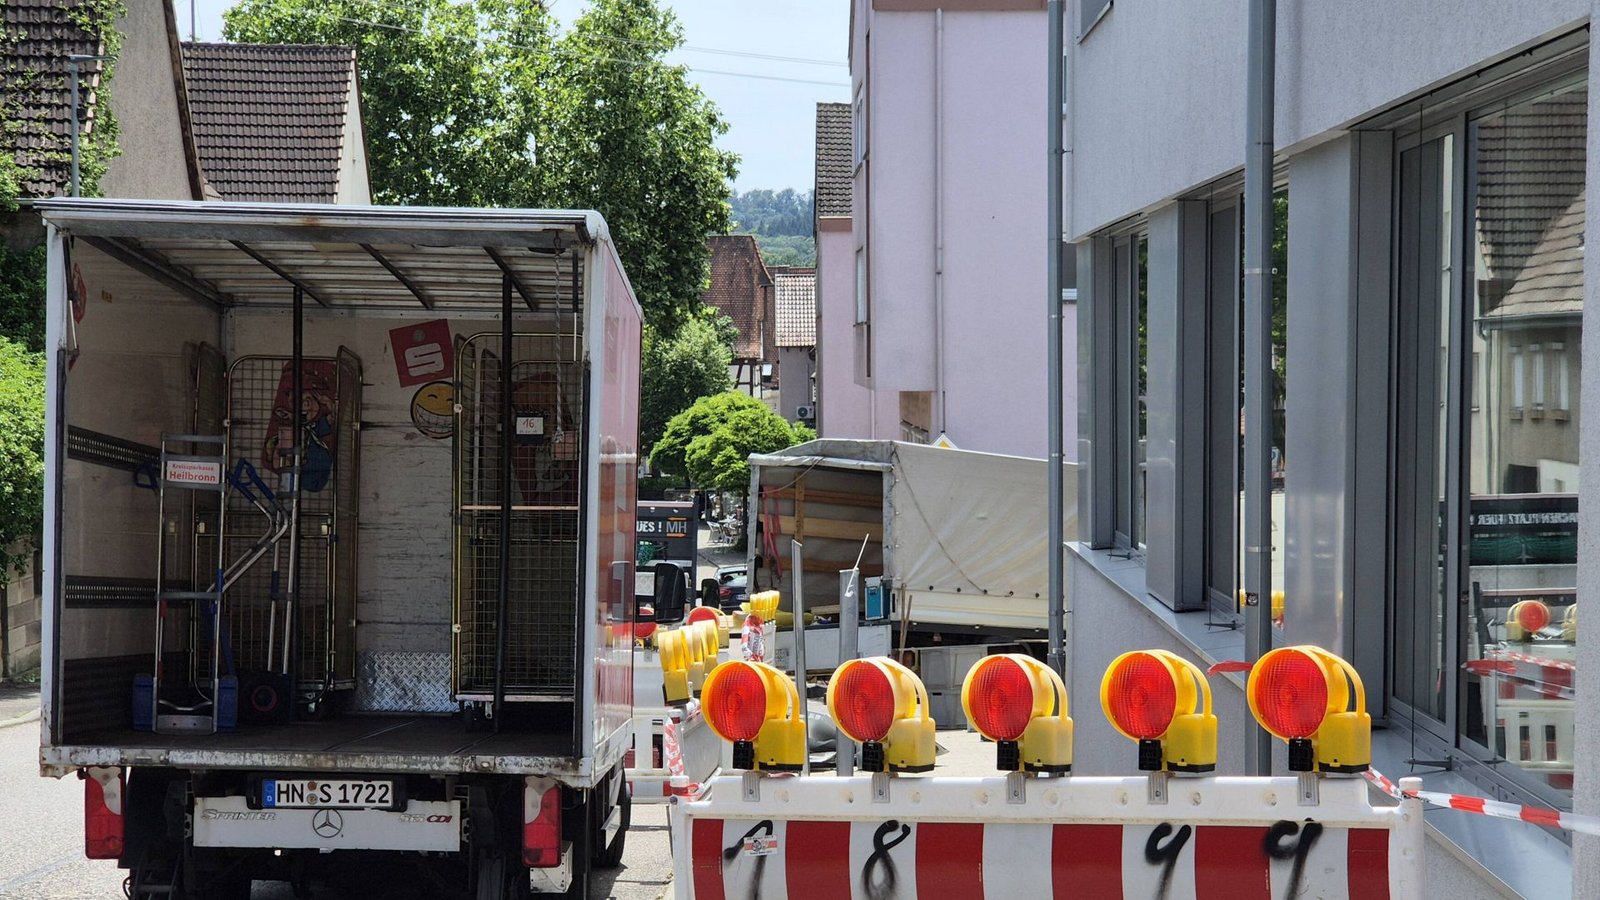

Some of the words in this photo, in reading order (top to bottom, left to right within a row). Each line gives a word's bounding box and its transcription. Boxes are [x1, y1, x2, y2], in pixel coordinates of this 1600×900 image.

[522, 418, 535, 428] 16
[172, 463, 214, 471] Kreissparkasse
[169, 471, 216, 482] Heilbronn
[666, 521, 687, 533] MH
[277, 783, 304, 803] HN
[319, 783, 332, 803] S
[338, 784, 389, 804] 1722
[201, 808, 276, 821] SPRINTER
[426, 814, 452, 823] CDI
[860, 820, 911, 900] 8
